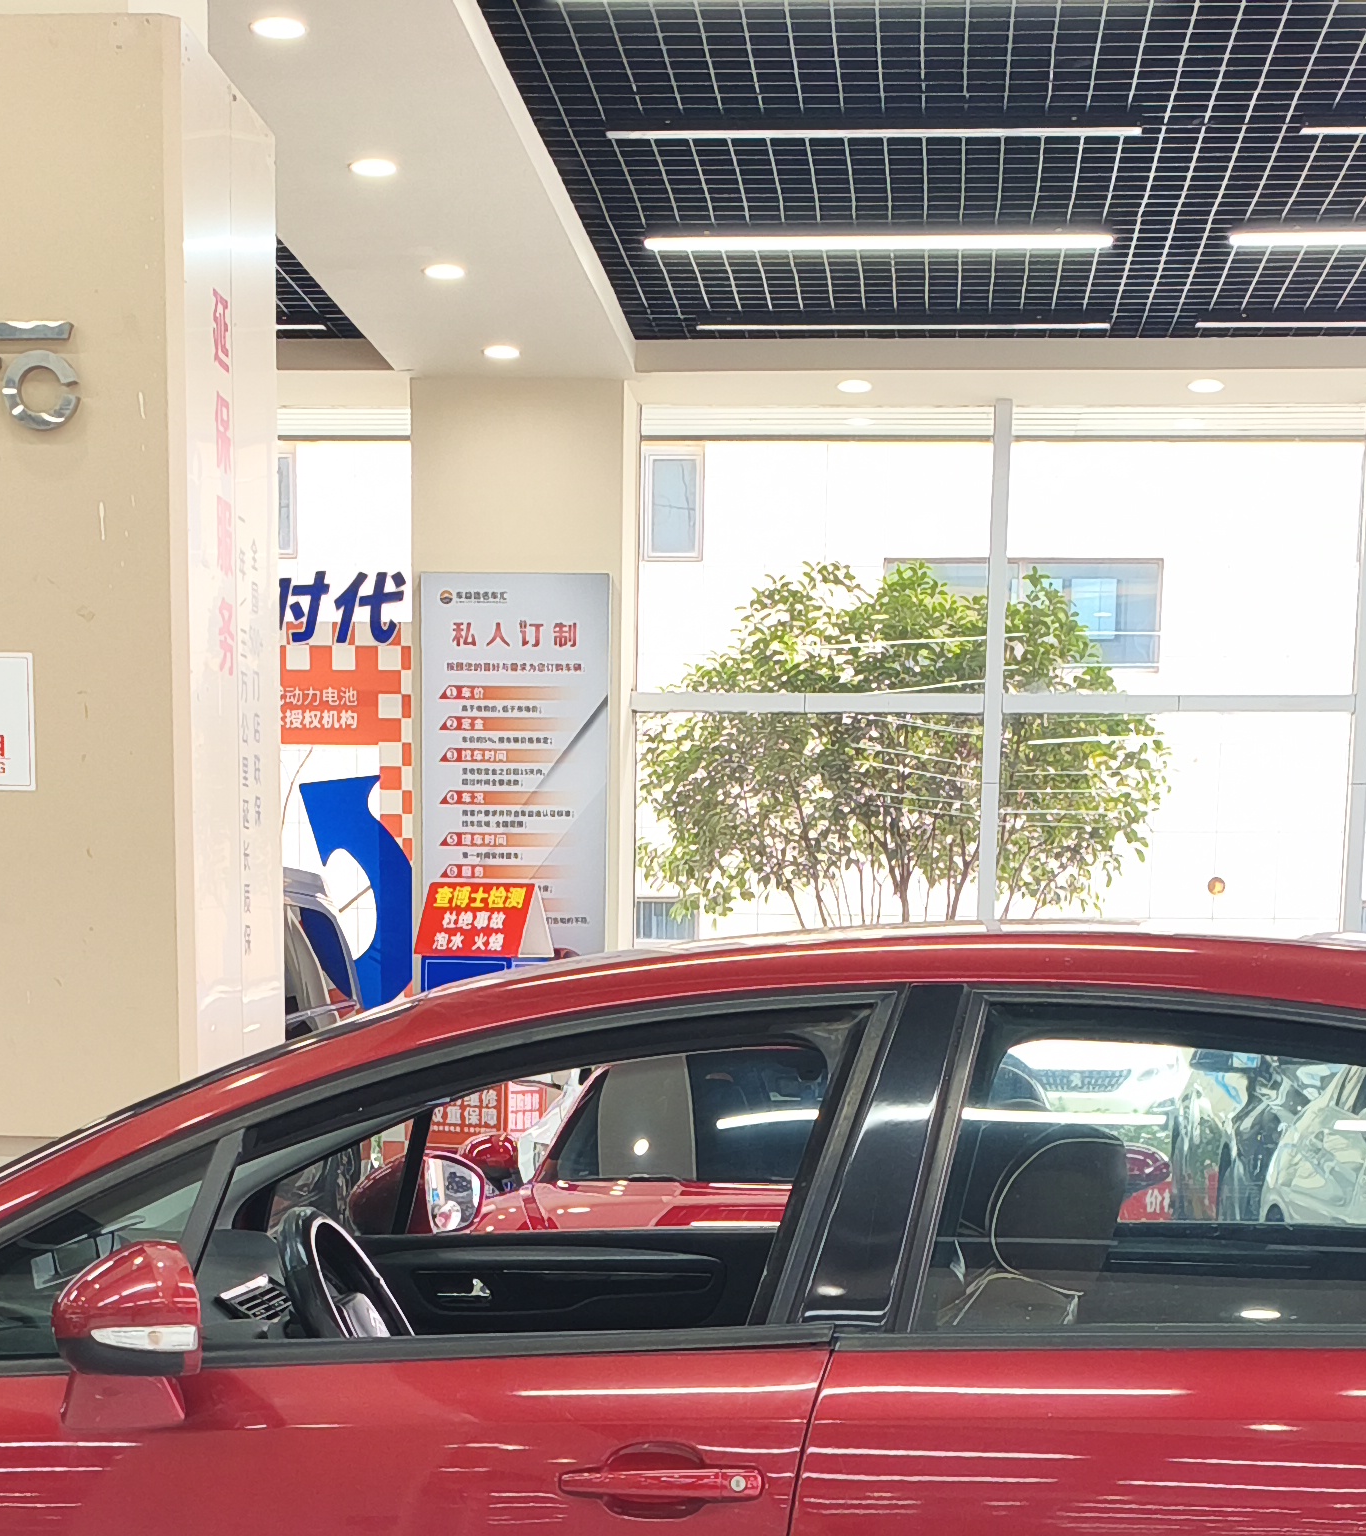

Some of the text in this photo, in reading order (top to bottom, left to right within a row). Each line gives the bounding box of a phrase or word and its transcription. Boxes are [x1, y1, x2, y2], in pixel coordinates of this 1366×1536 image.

[212, 287, 234, 677] 延保服务
[452, 620, 578, 648] 私人订制
[281, 686, 358, 706] 动力电池
[462, 686, 484, 699] 车价
[281, 709, 358, 730] 授权机构
[462, 718, 484, 730] 定金
[462, 792, 485, 804] 车况
[433, 885, 527, 909] 查博士检测
[442, 911, 506, 929] 杜绝事故
[432, 932, 506, 951] 泡水 火烧
